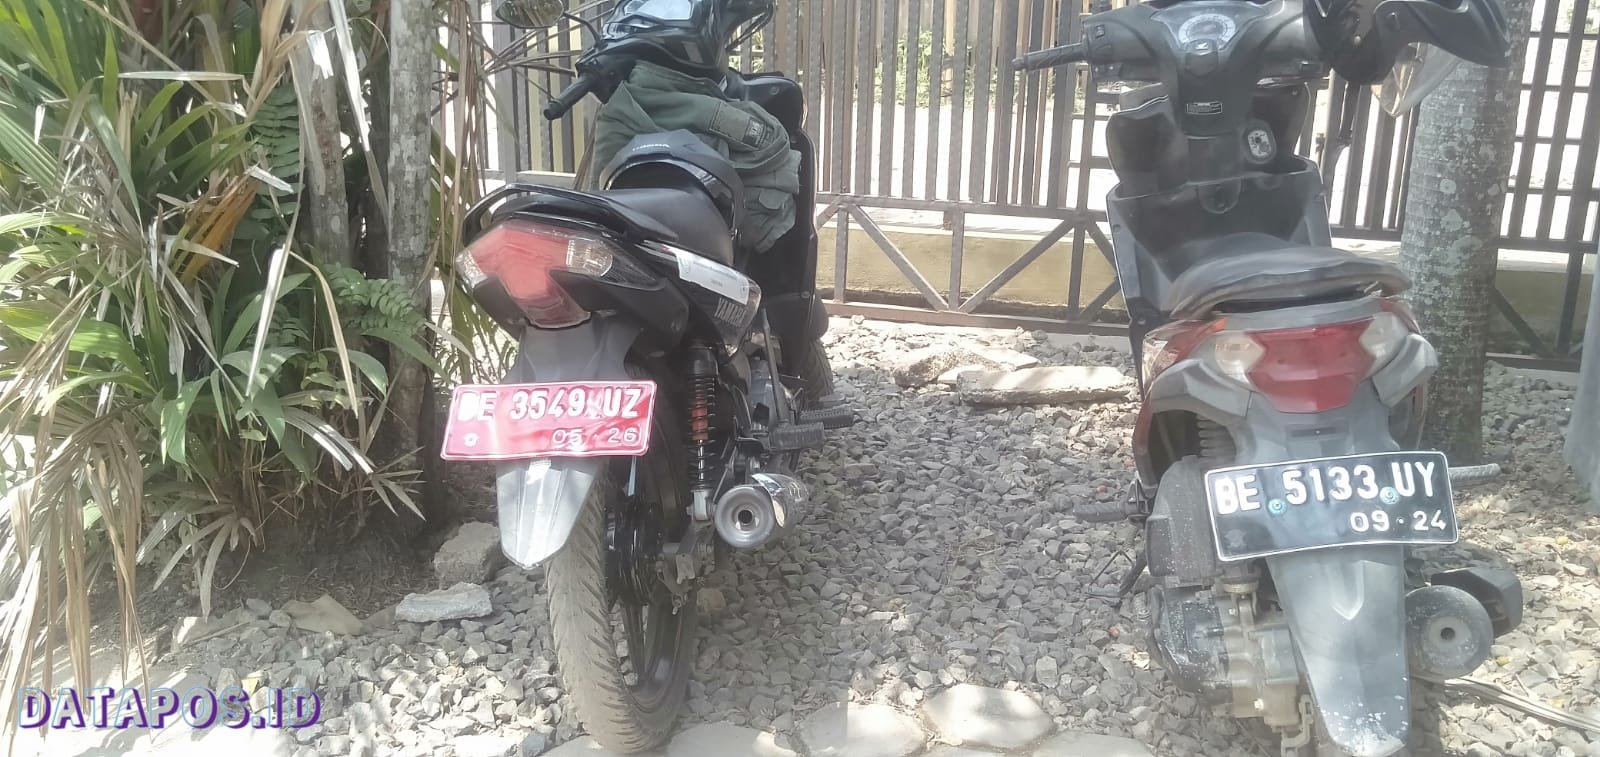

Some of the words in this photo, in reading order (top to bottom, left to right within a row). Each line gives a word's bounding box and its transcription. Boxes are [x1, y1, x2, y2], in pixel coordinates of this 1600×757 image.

[510, 388, 586, 420] 3549
[603, 388, 641, 418] UZ
[608, 427, 638, 443] 26
[1214, 475, 1261, 514] BE
[1282, 464, 1379, 505] 5133
[1391, 461, 1435, 497] UY
[1350, 510, 1390, 532] 09
[1412, 509, 1447, 531] 24
